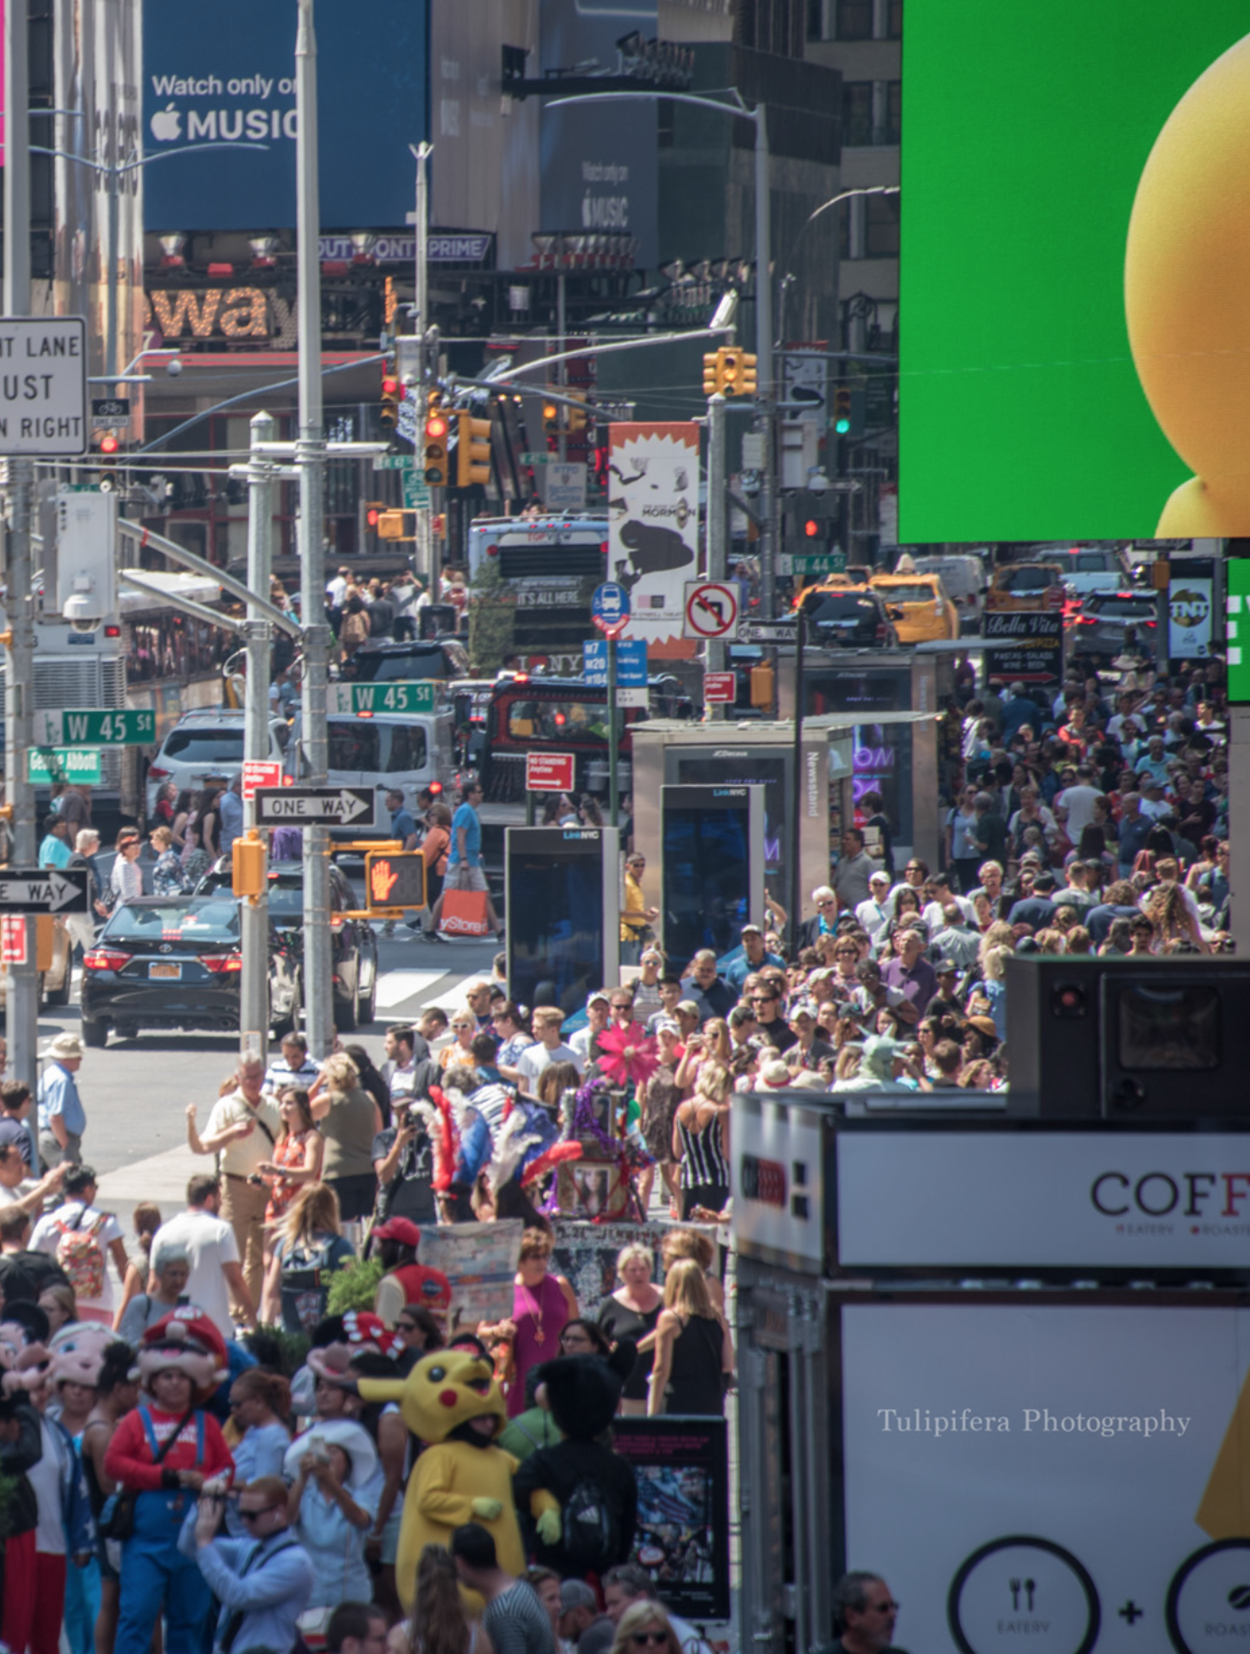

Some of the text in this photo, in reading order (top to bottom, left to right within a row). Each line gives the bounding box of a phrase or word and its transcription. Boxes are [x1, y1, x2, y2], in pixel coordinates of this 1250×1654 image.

[152, 75, 223, 96] Watch
[226, 74, 274, 99] only
[188, 110, 298, 141] MUSIC
[593, 197, 629, 228] MUSIC
[431, 236, 483, 257] PRIME
[143, 286, 297, 350] way
[26, 336, 80, 357] LANE
[20, 416, 82, 438] RIGHT
[795, 557, 845, 573] W 44 St
[517, 590, 579, 606] IT'S ALL HERE
[1170, 601, 1209, 618] TNT
[738, 626, 762, 639] ONE
[987, 614, 1060, 635] Bella Vita
[585, 643, 600, 655] M7
[548, 654, 583, 672] NY
[585, 658, 606, 670] M20
[356, 686, 430, 710] W 45 St
[67, 714, 152, 741] W 45 St
[30, 750, 98, 774] George Abbott
[529, 757, 567, 766] NO STANDING
[713, 788, 748, 798] LinkNYC
[807, 751, 819, 818] Newsstand
[271, 800, 356, 815] ONE WAY
[563, 831, 600, 840] LinkNYC
[28, 883, 68, 900] WAY
[1127, 1224, 1175, 1235] EATERY
[997, 1620, 1050, 1635] EATERY
